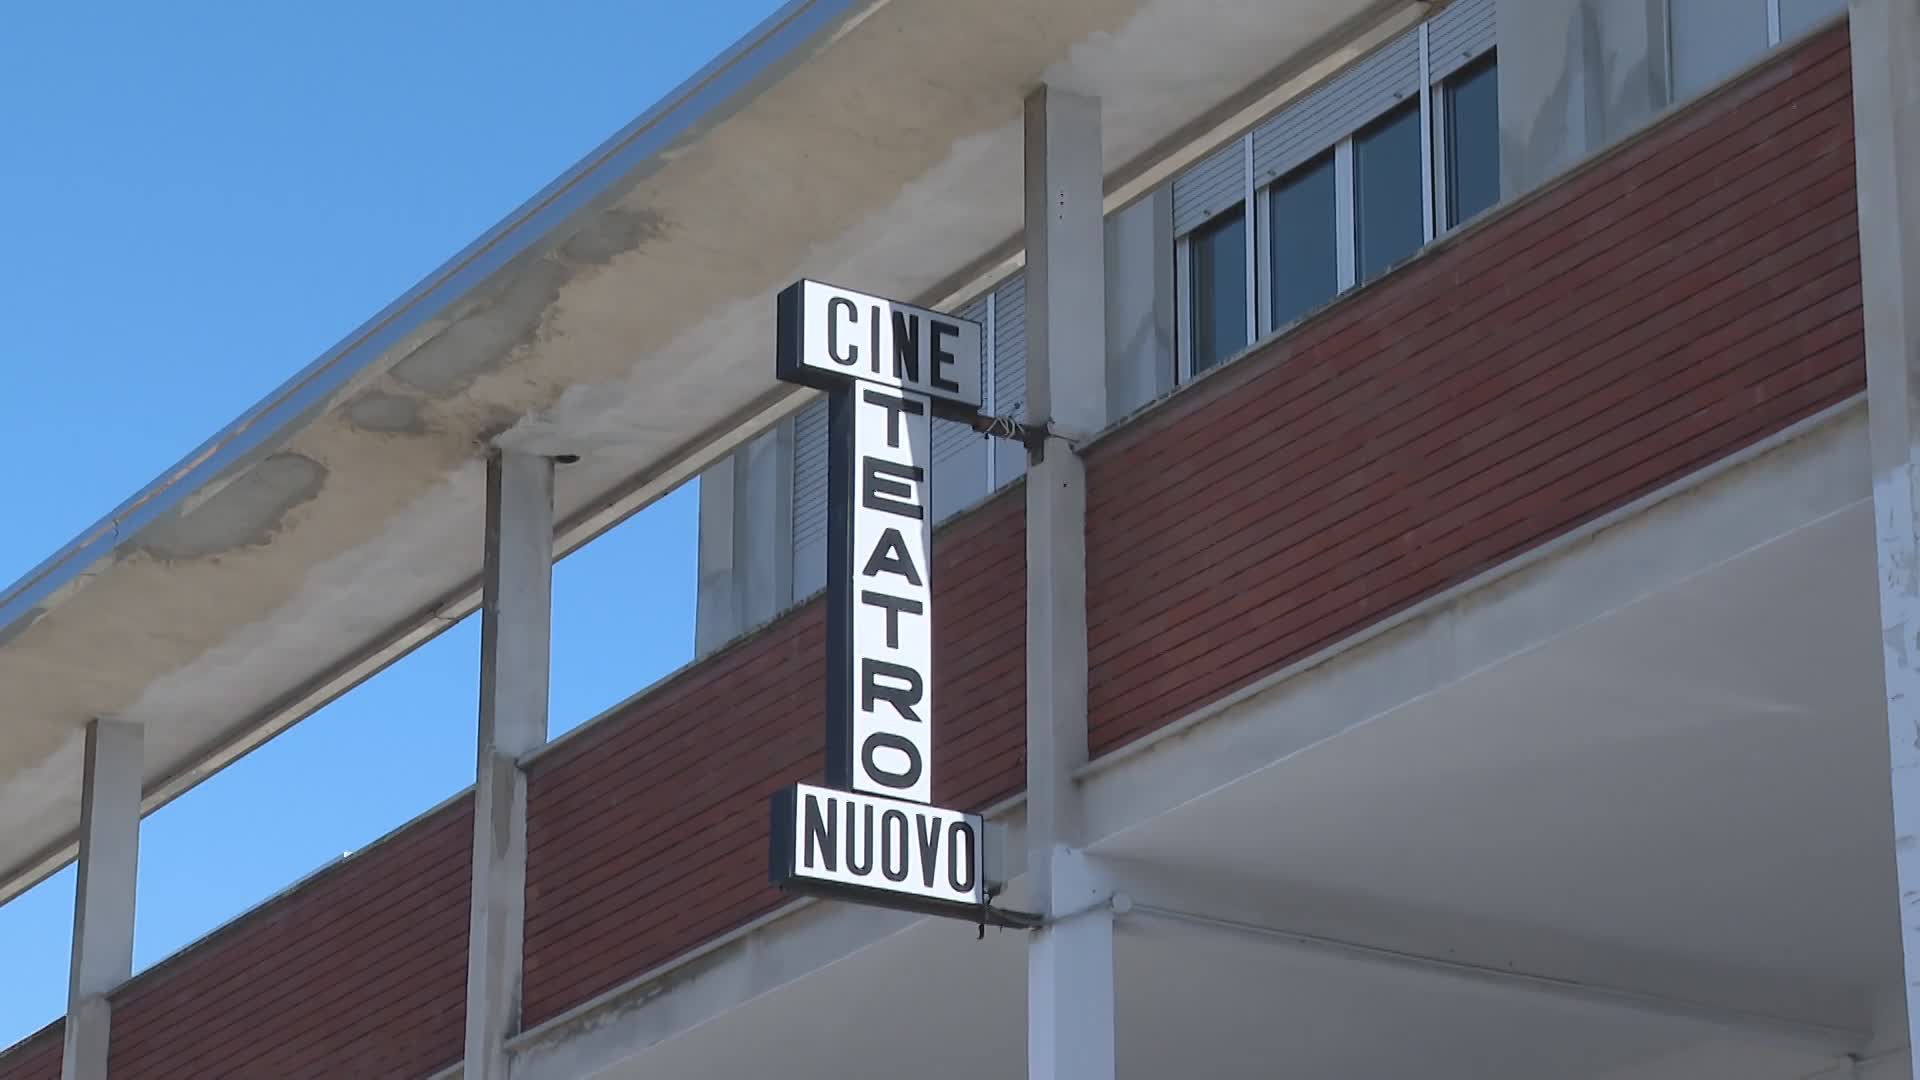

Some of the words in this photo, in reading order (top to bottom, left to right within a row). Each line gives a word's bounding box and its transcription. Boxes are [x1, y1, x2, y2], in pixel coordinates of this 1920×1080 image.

[827, 296, 960, 393] CINE
[861, 389, 923, 790] TEATRO
[804, 793, 975, 893] NUOVO
